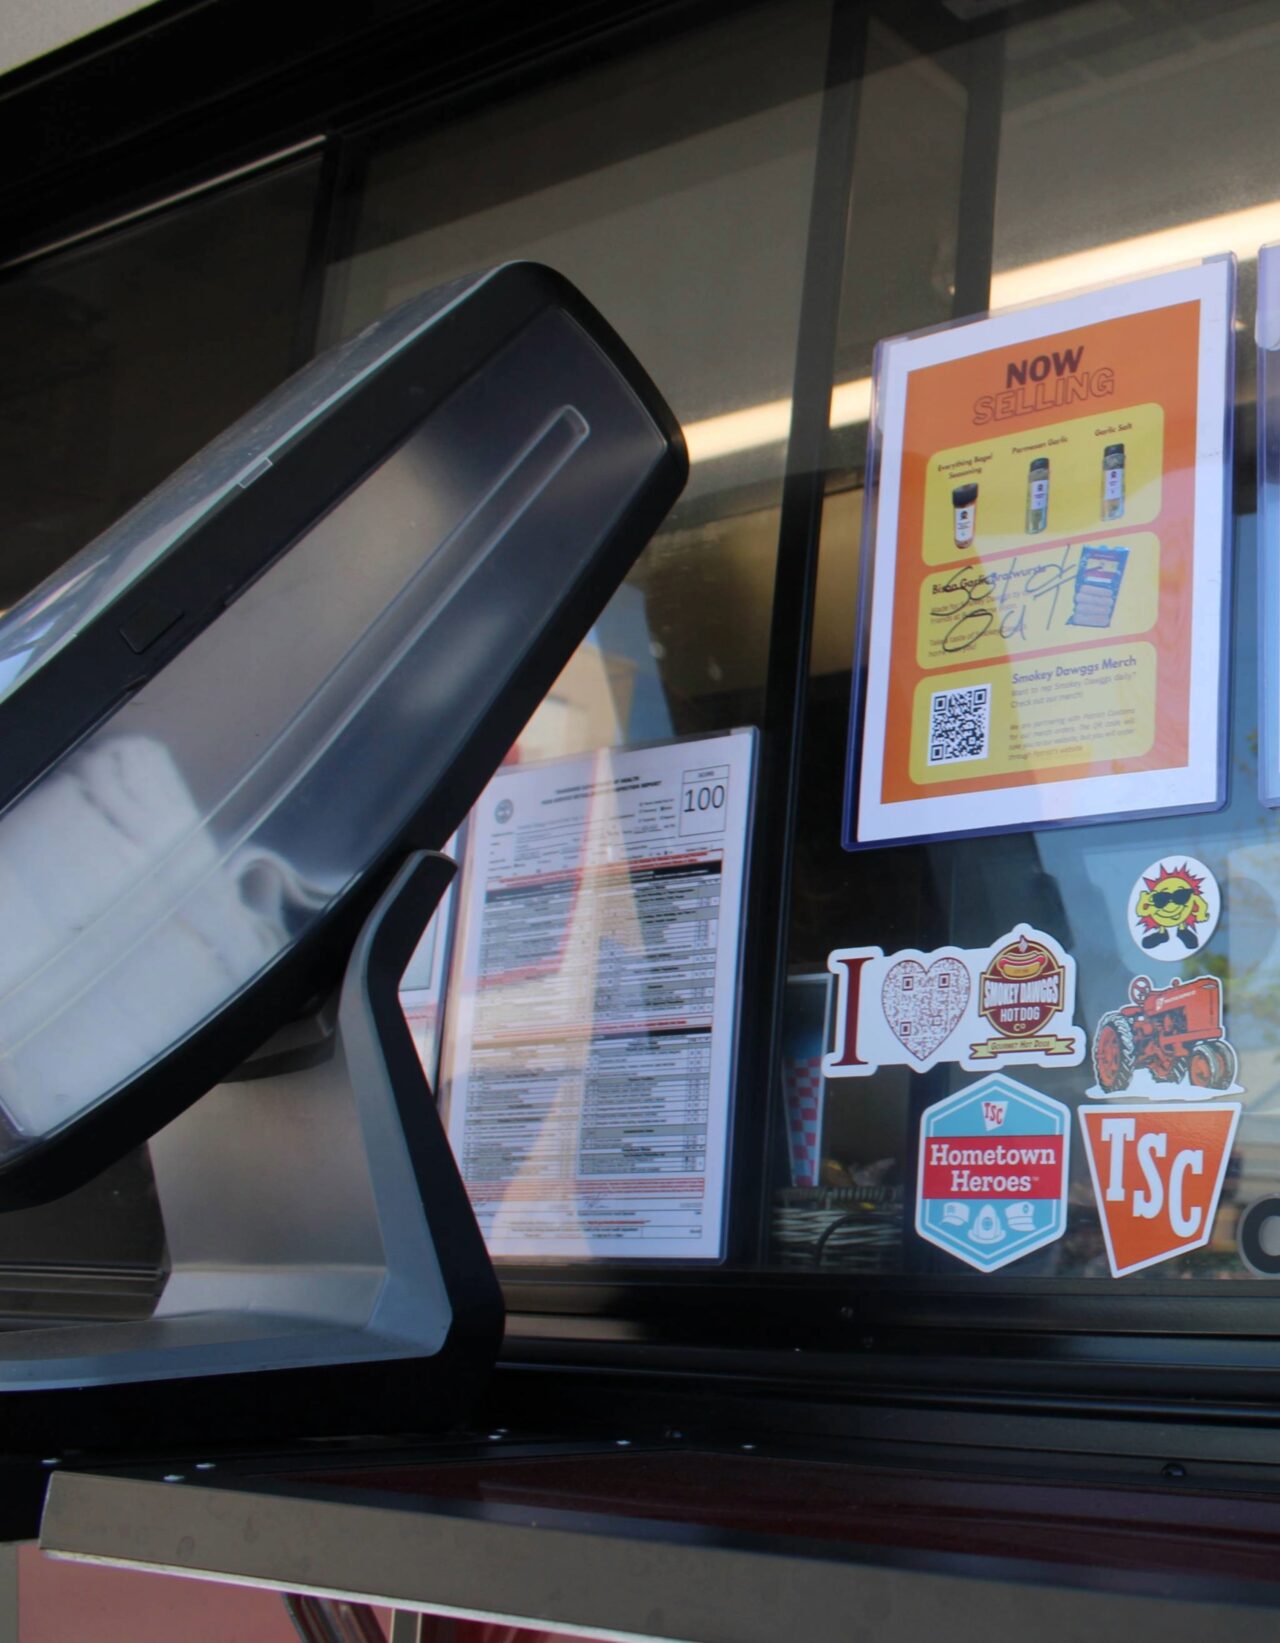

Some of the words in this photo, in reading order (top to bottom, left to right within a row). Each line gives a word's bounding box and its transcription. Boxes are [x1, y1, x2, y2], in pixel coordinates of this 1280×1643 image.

[1006, 346, 1085, 389] NOW
[972, 367, 1114, 426] SELLING
[1011, 669, 1054, 685] Smokey
[1055, 662, 1099, 677] Dawggs
[1101, 654, 1137, 670] Merch
[683, 784, 725, 813] 100
[830, 956, 875, 1067] I
[1000, 1007, 1020, 1022] HOT
[1020, 1006, 1040, 1021] DOG
[984, 1102, 1003, 1124] TSC
[929, 1143, 1057, 1166] Hometown
[1101, 1118, 1204, 1238] TSC
